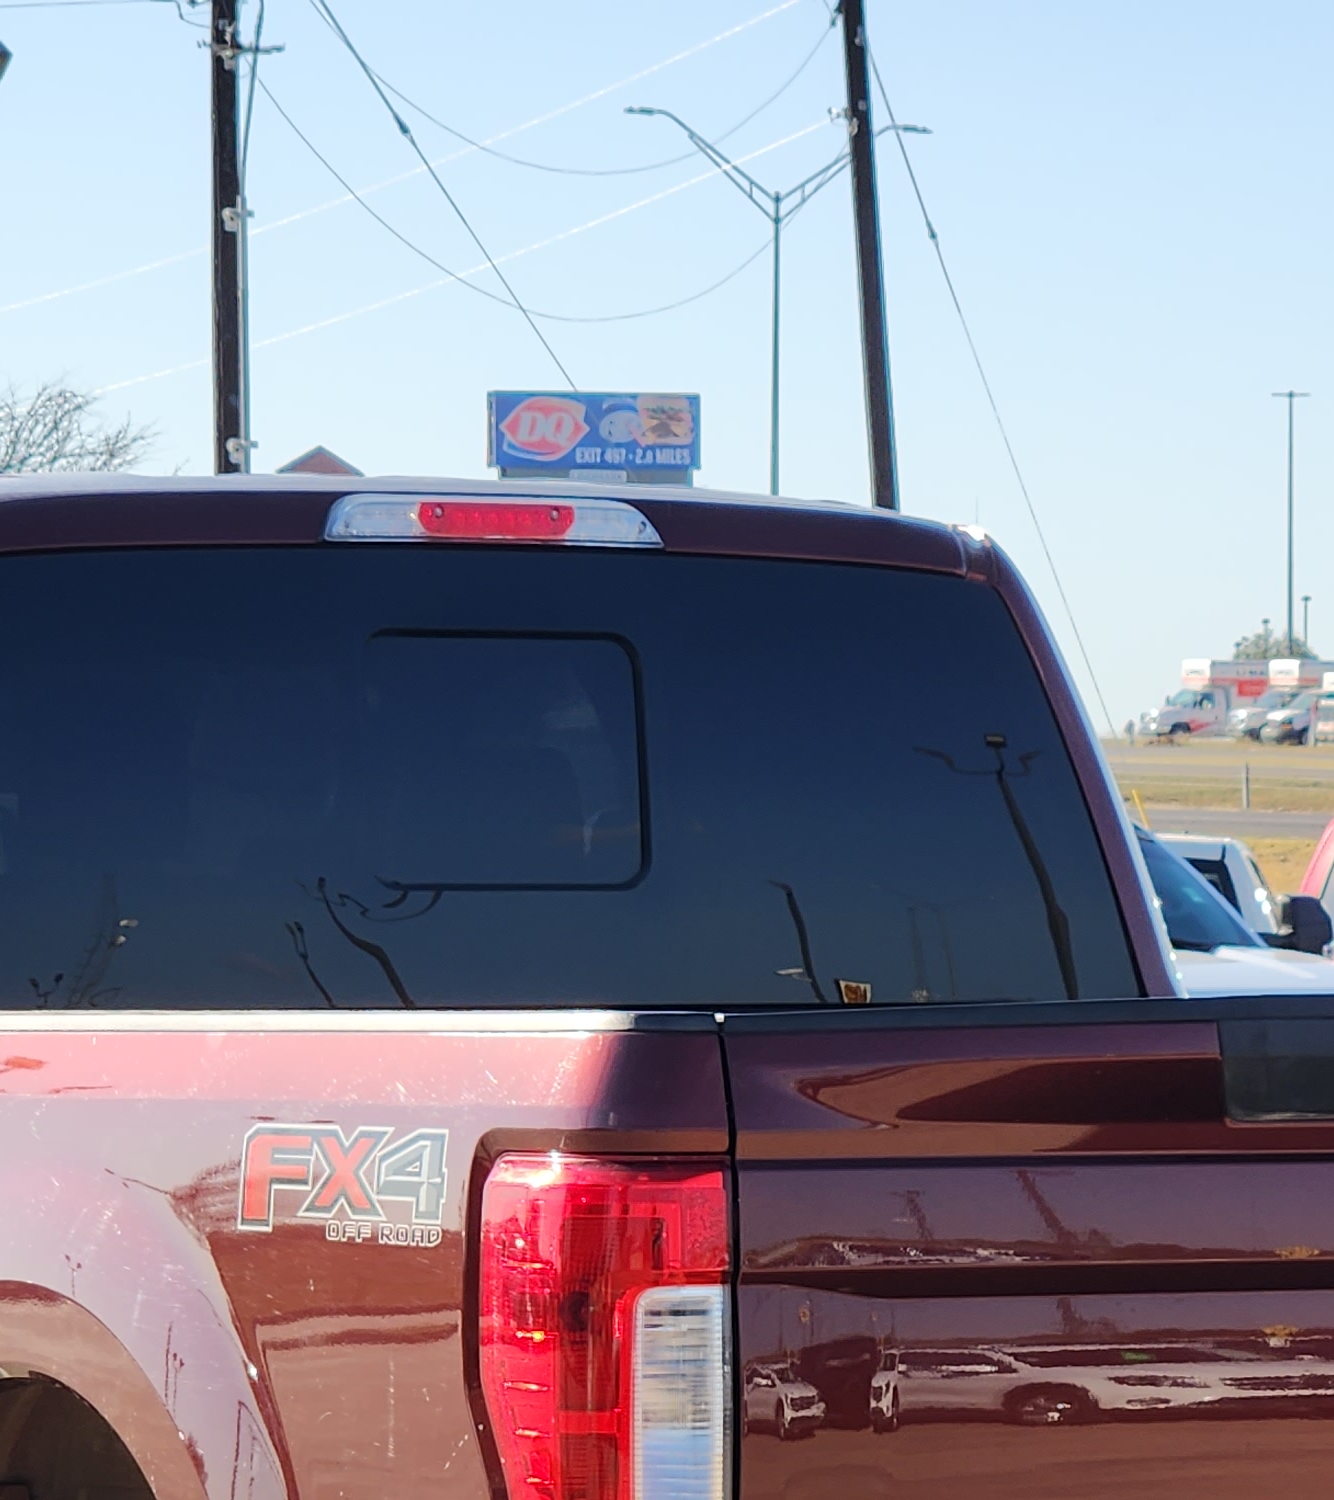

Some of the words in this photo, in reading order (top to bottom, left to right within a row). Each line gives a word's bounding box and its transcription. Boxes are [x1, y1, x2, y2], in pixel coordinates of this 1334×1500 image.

[517, 410, 576, 447] DQ
[575, 447, 602, 464] EXIT
[655, 448, 691, 465] MILES
[237, 1122, 450, 1233] FX4
[325, 1220, 372, 1243] OFF
[378, 1222, 443, 1248] ROAD
